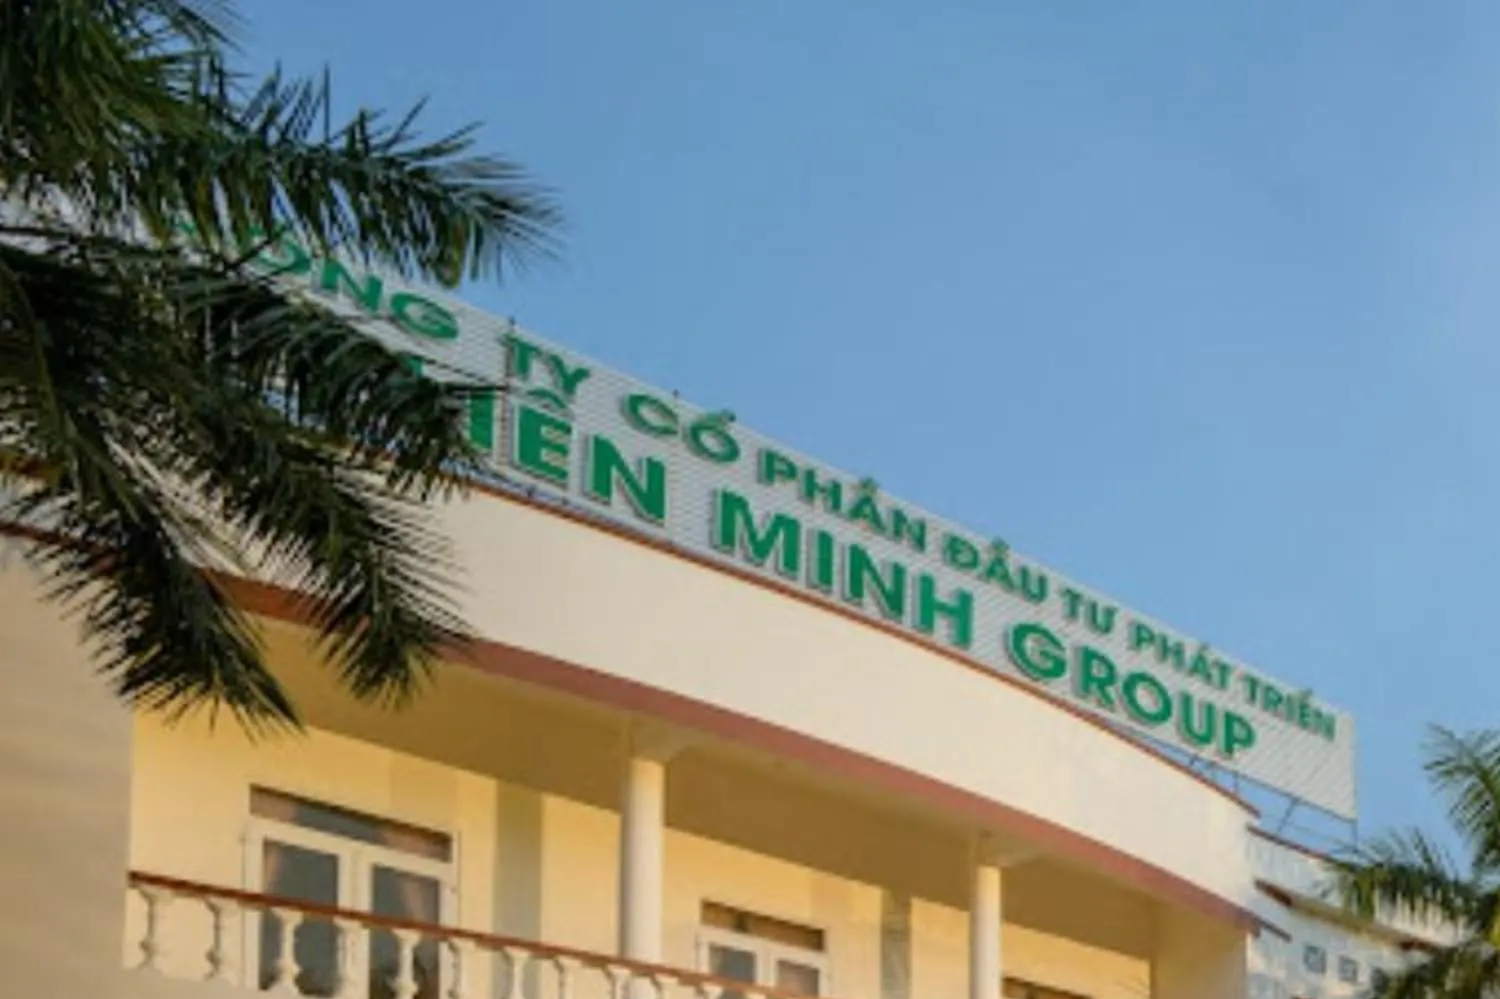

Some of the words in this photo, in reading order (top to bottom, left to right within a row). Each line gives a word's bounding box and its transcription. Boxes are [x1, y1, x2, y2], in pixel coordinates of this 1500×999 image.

[501, 330, 591, 396] TY
[712, 487, 975, 648] MINH
[1005, 620, 1258, 760] GROUP
